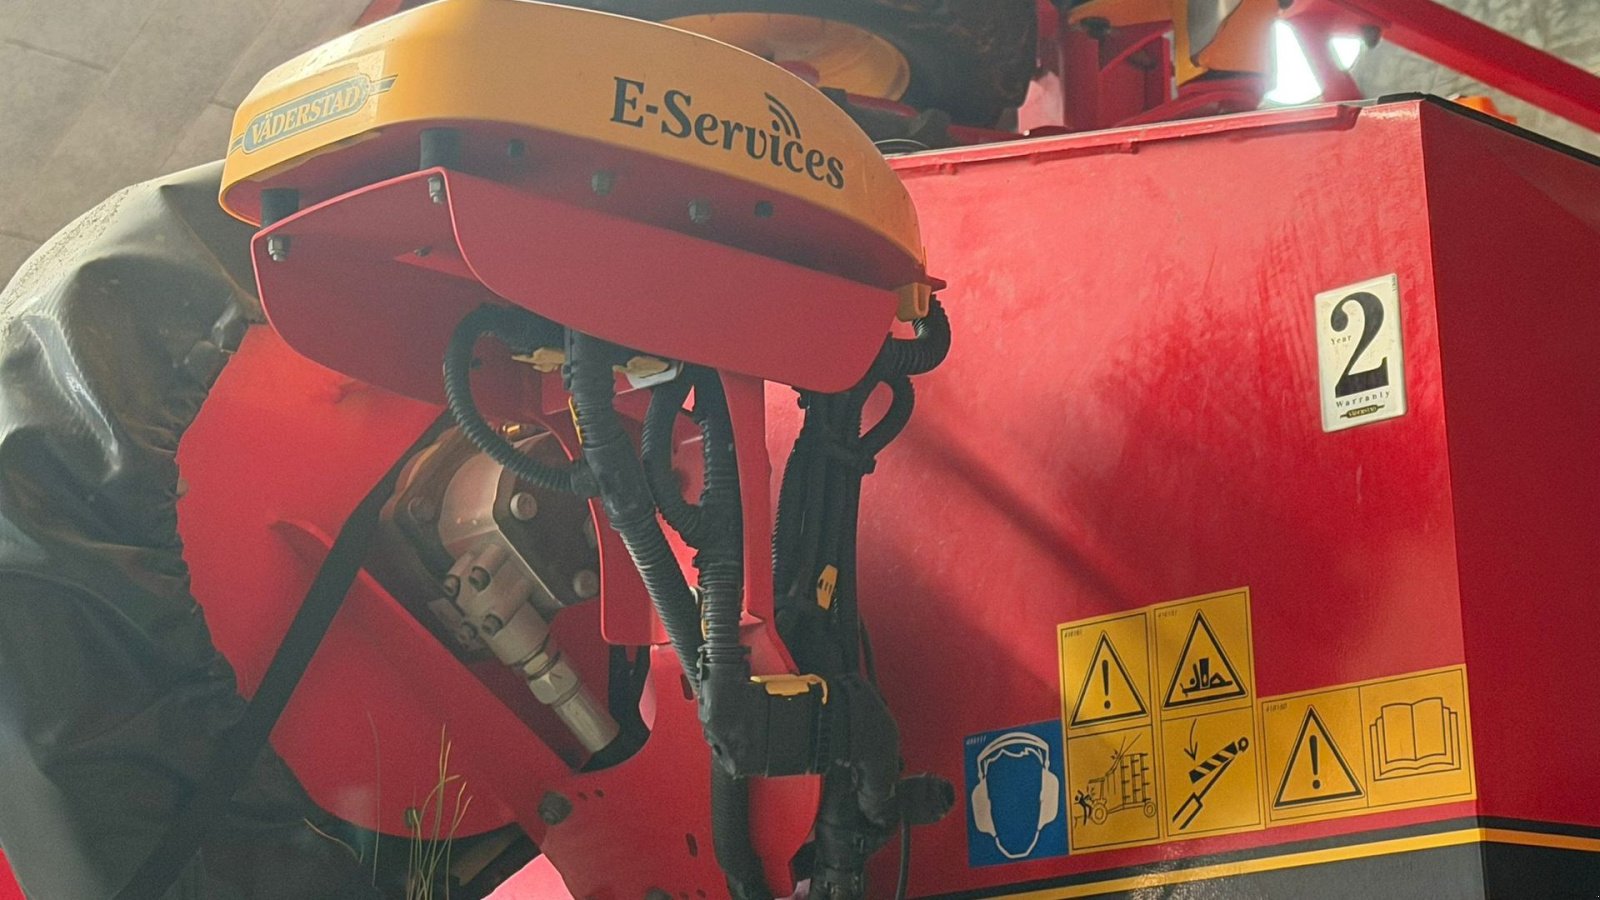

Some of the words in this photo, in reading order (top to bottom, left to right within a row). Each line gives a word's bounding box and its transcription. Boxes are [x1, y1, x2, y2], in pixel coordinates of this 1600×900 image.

[251, 85, 360, 145] VÄDERSTAD
[610, 76, 844, 189] E-Services
[1331, 334, 1352, 345] Year
[1331, 291, 1389, 398] 2
[1336, 391, 1390, 407] Warranty
